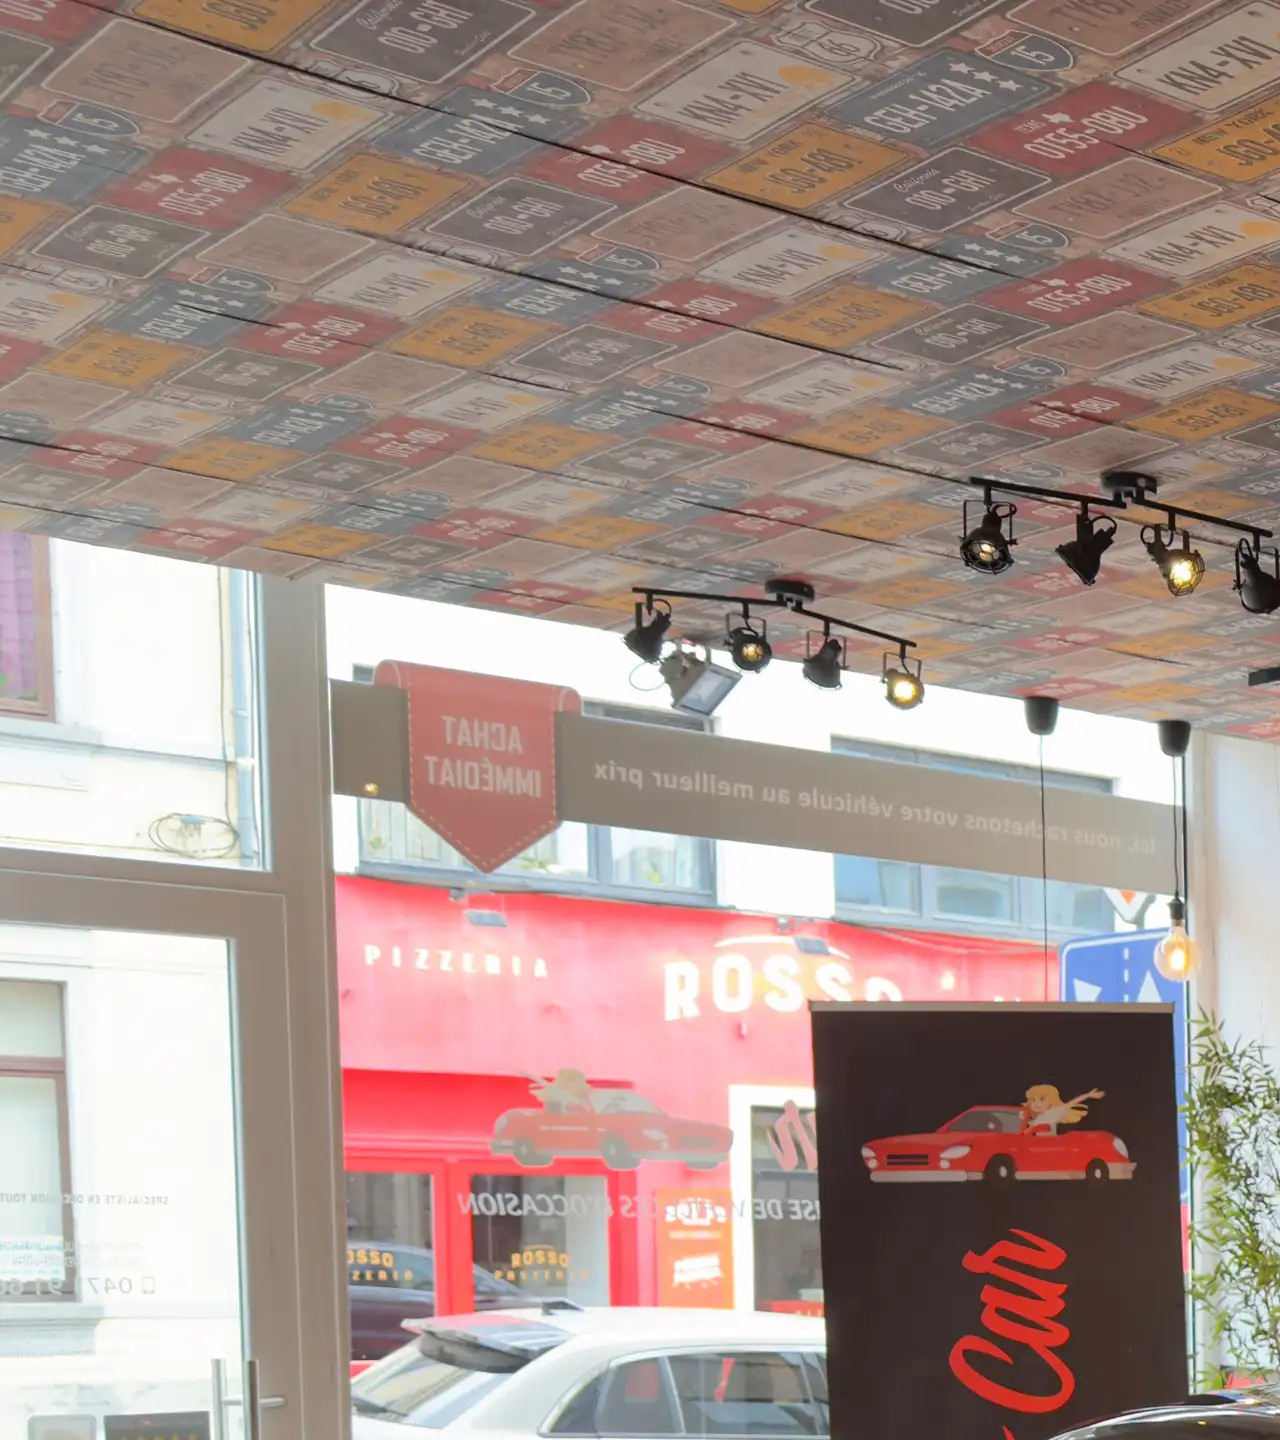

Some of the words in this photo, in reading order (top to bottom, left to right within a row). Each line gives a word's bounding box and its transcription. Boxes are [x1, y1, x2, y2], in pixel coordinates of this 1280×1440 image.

[1011, 44, 1056, 66] 15
[364, 944, 548, 979] PIZZERIA
[949, 1227, 1075, 1414] Car
